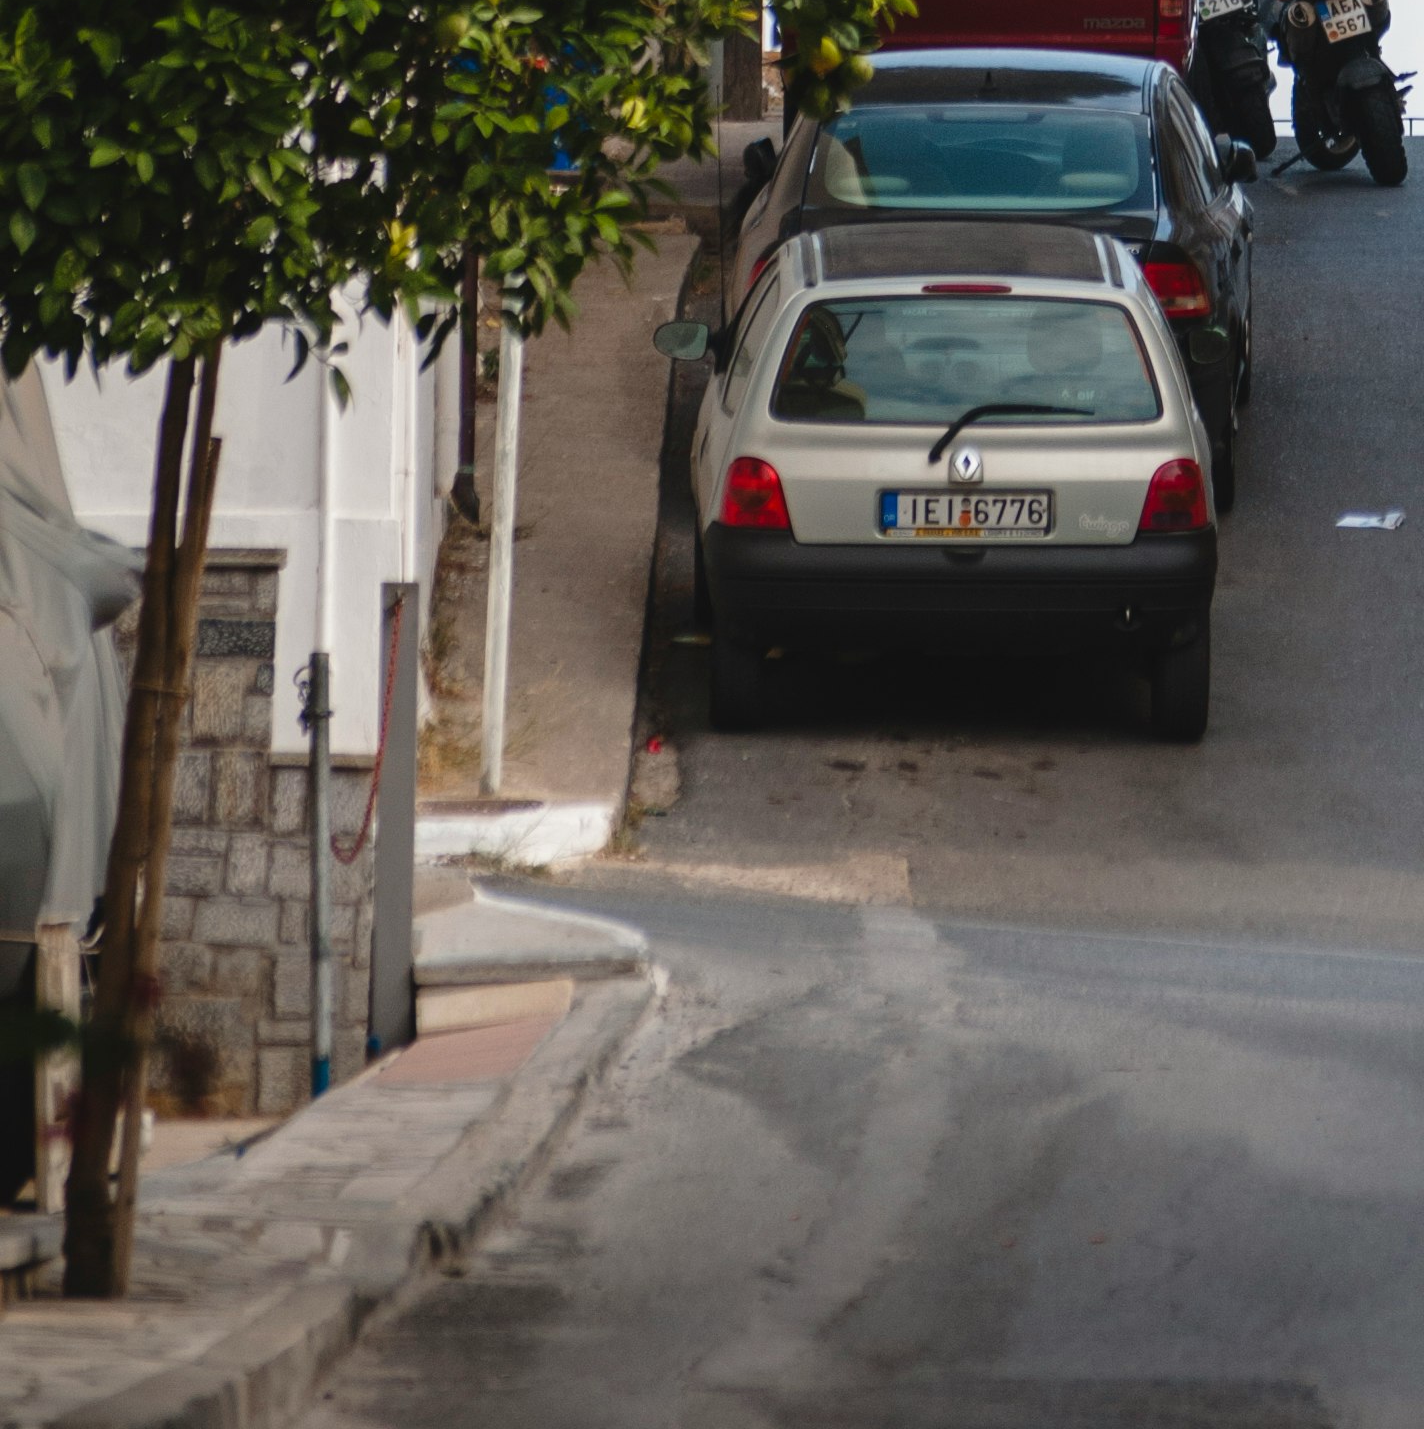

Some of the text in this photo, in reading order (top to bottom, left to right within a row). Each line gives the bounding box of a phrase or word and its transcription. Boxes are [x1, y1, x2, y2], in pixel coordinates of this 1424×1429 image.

[1335, 14, 1367, 35] 567
[911, 497, 1045, 526] IEI 6776
